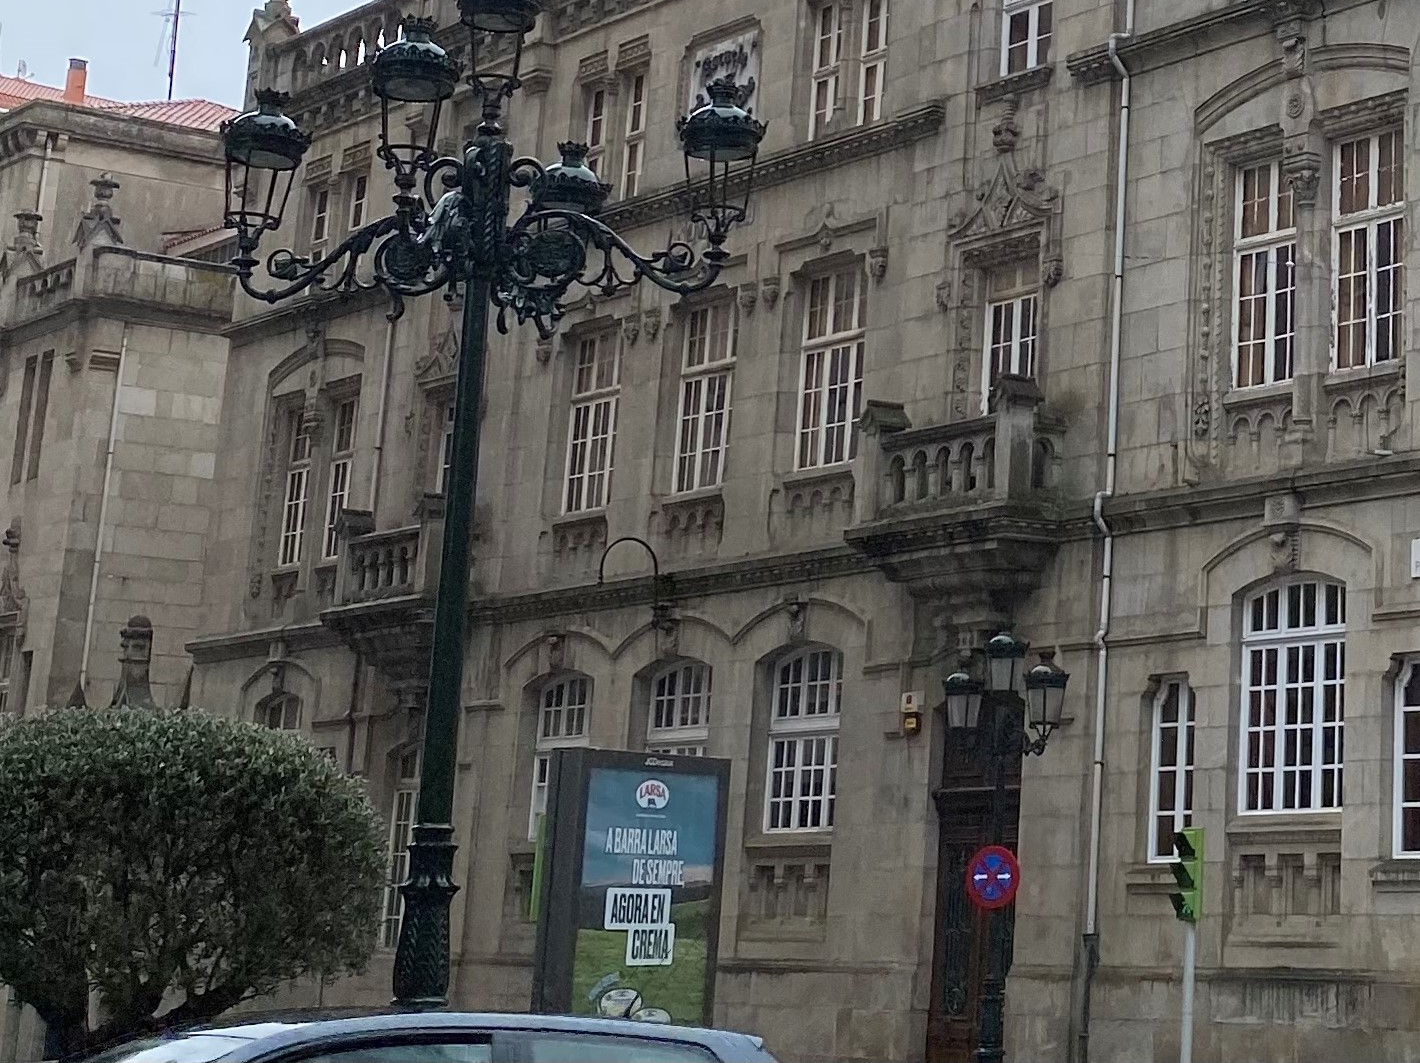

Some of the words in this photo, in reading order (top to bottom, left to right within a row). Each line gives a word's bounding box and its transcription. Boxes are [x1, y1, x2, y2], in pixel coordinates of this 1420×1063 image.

[639, 783, 666, 800] LARSA
[605, 827, 613, 853] A
[614, 828, 647, 854] BARRA
[647, 829, 677, 855] LARSA
[632, 859, 646, 884] DE
[610, 893, 649, 924] AGORA
[650, 894, 666, 924] EN
[631, 929, 668, 960] CREMA
